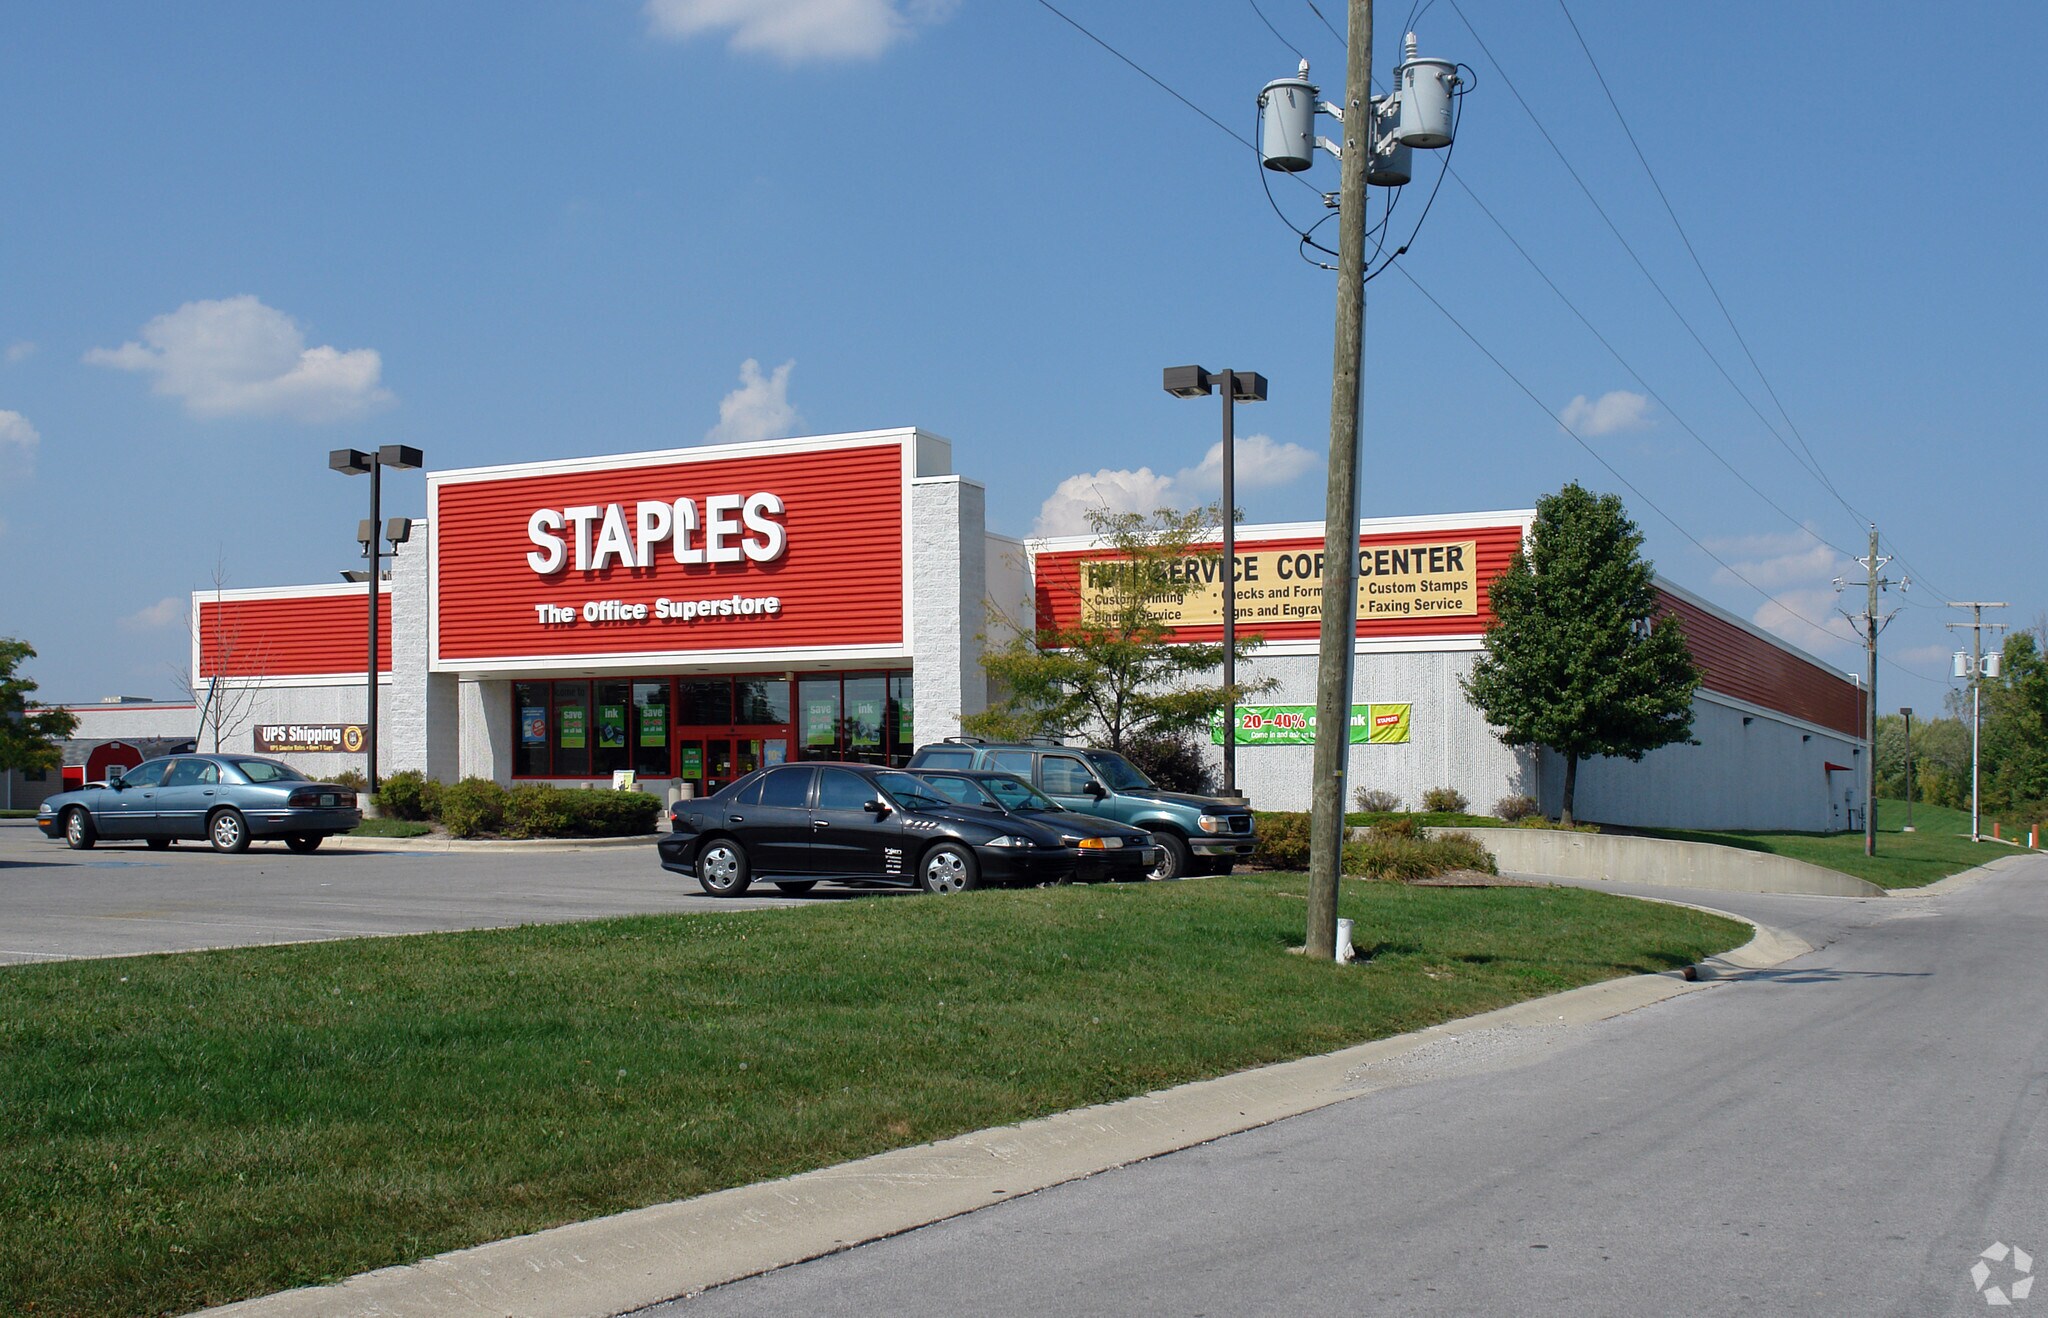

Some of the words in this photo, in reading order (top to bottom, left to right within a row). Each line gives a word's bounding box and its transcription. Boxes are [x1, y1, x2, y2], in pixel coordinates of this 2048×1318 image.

[526, 492, 786, 574] STAPLES
[1277, 553, 1324, 580] COP
[1358, 545, 1464, 577] CENTER
[1222, 587, 1264, 600] ecks
[1268, 586, 1290, 598] and
[1293, 585, 1323, 598] Form
[1368, 582, 1416, 594] Custom
[1420, 580, 1468, 594] Stamps
[535, 604, 575, 624] The
[583, 600, 648, 623] Office
[655, 595, 780, 621] Superstore
[1257, 604, 1279, 617] and
[1283, 603, 1322, 618] Engrav
[1369, 599, 1410, 614] Faxing
[1414, 597, 1463, 611] Service
[563, 711, 582, 719] save
[605, 708, 618, 718] ink
[643, 708, 662, 717] save
[810, 705, 832, 714] save
[858, 703, 873, 714] ink
[1350, 713, 1366, 727] nk
[1376, 715, 1399, 725] STAPLES
[262, 726, 286, 742] UPS
[288, 725, 341, 744] Shipping
